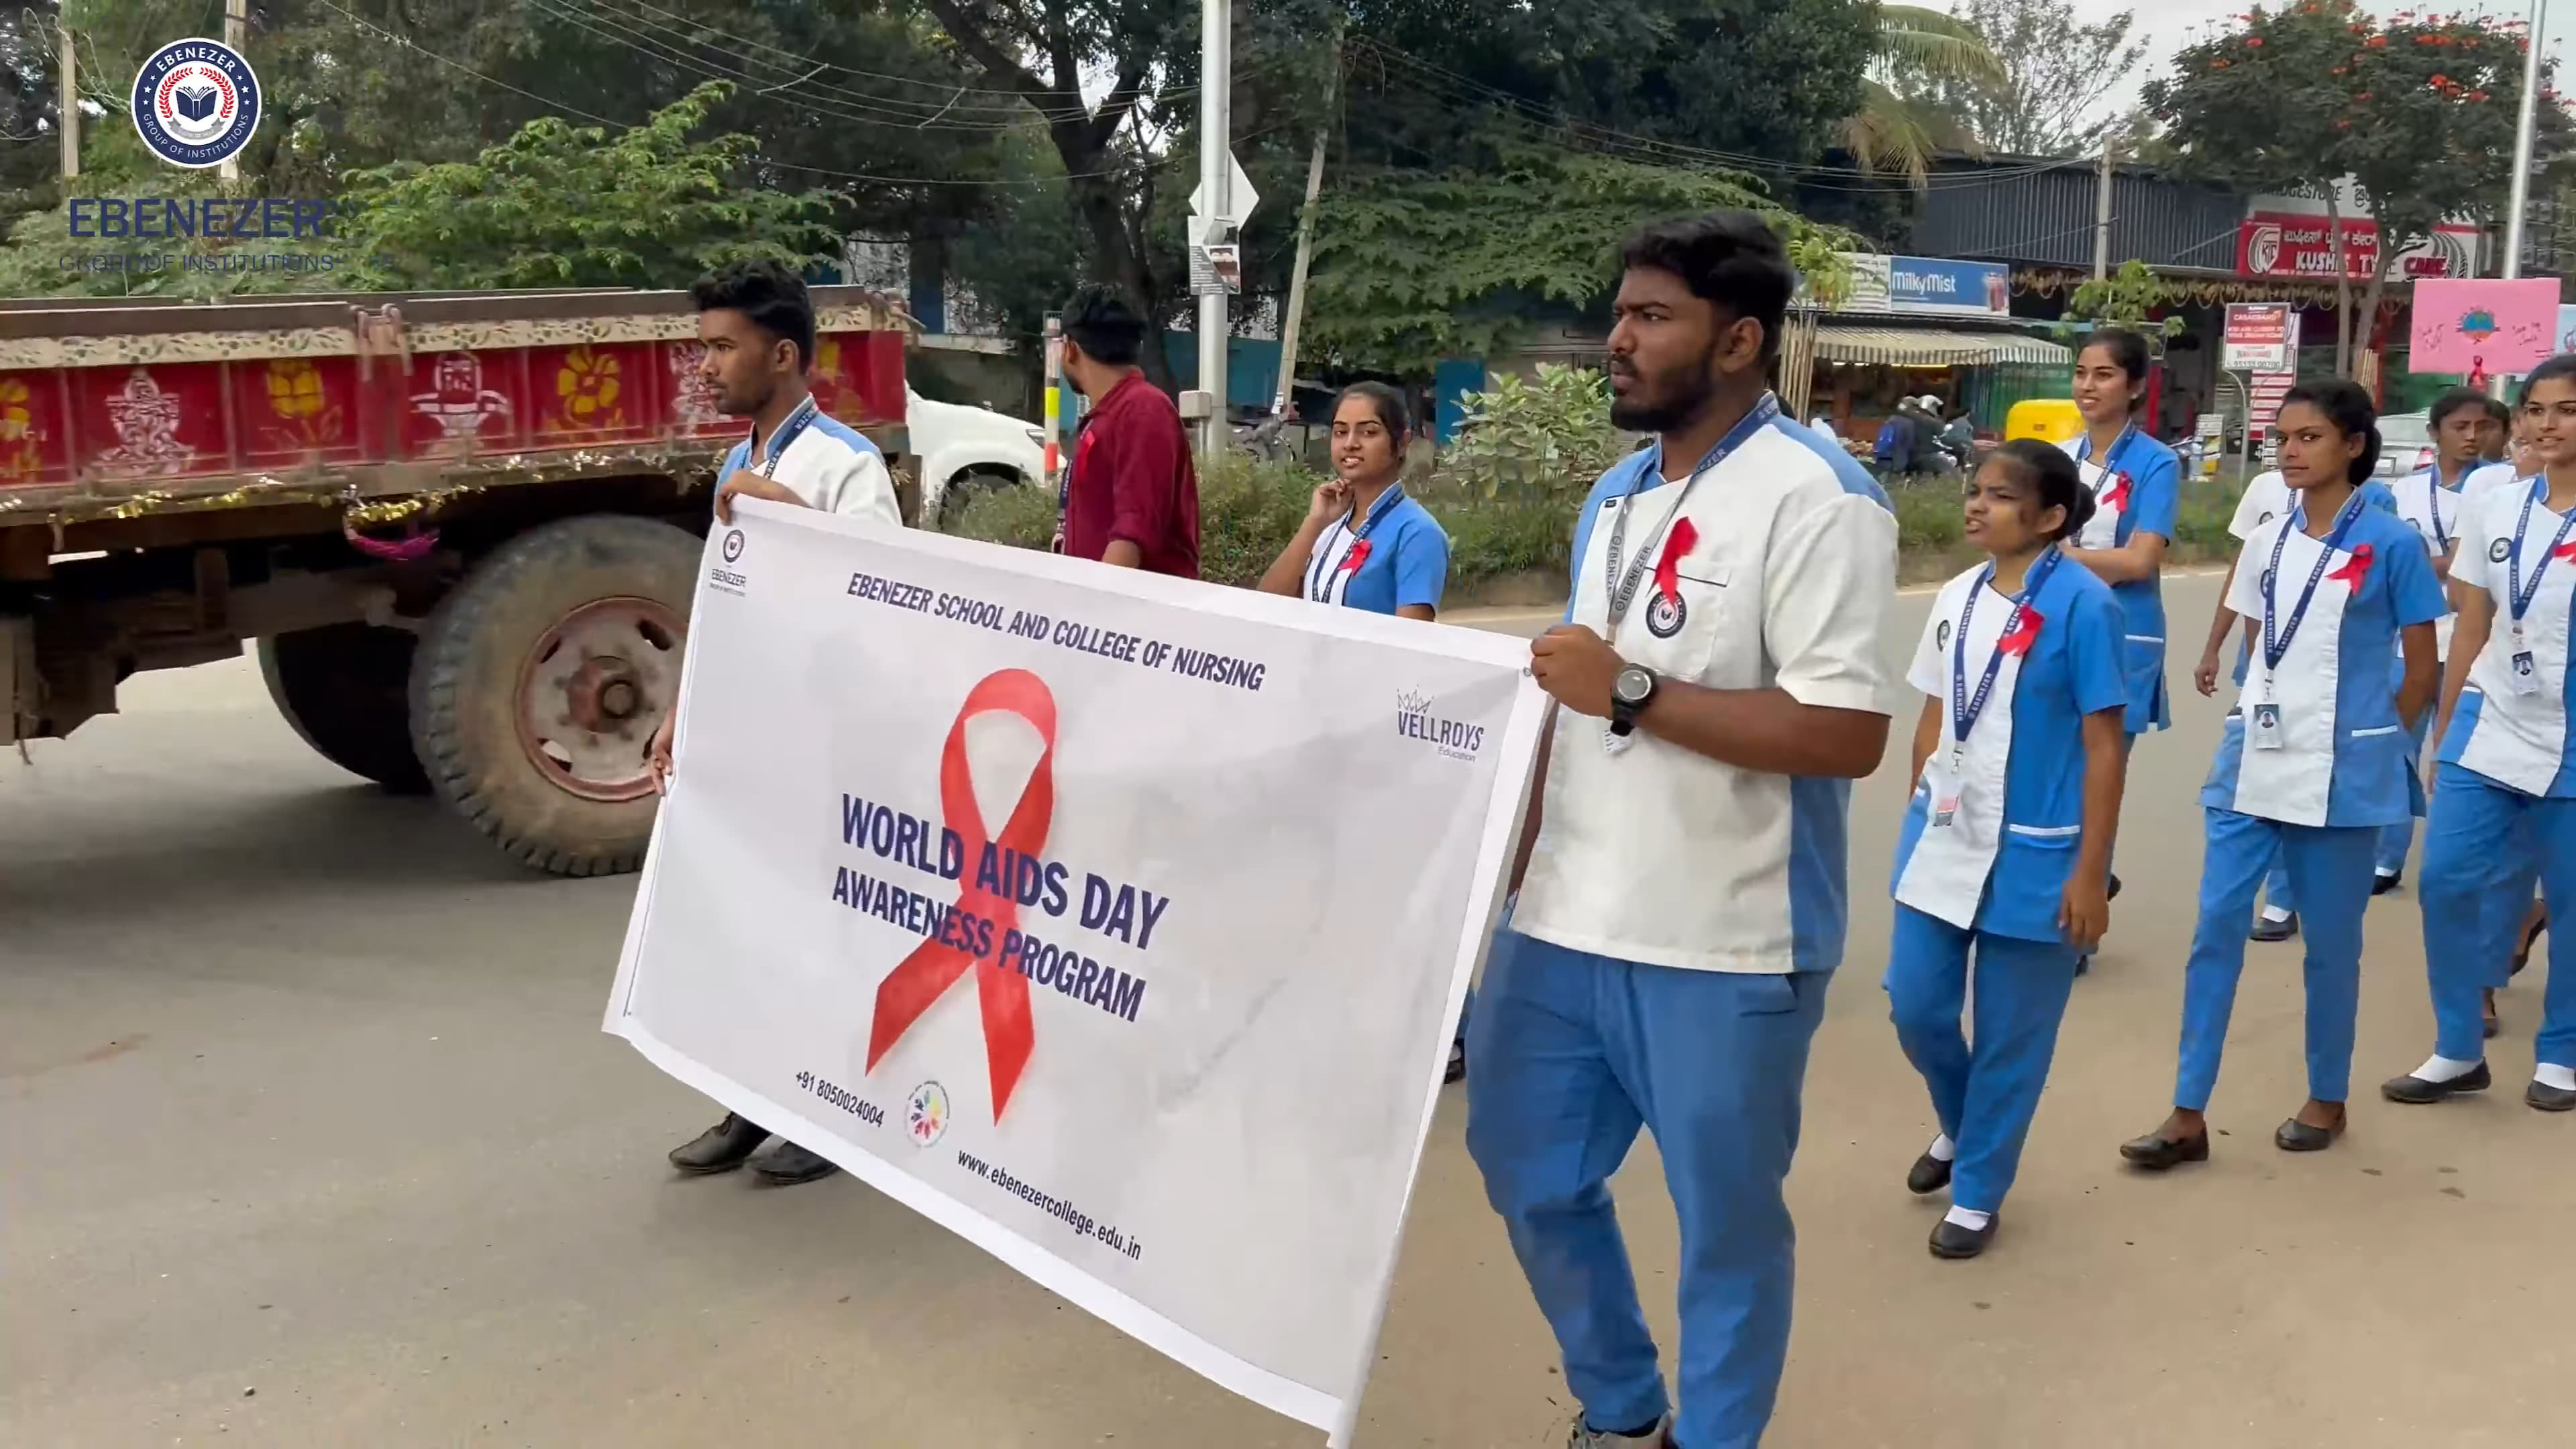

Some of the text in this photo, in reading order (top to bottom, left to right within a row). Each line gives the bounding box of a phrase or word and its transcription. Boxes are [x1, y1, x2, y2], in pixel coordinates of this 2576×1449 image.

[712, 569, 746, 587] EBENEZER
[1619, 546, 1652, 601] EBENEZER
[847, 573, 1266, 691] EBENEZER SCHOOL AND COLLEGE OF NURSING
[1399, 711, 1484, 751] VELLROYS
[843, 794, 1169, 950] WORLD AIDS DAY
[833, 867, 1146, 1022] AWARENESS PROGRAM
[796, 1071, 815, 1092] +91
[817, 1080, 885, 1128] 8050024004
[958, 1150, 1141, 1260] www.ebenezercollege.edu.in
